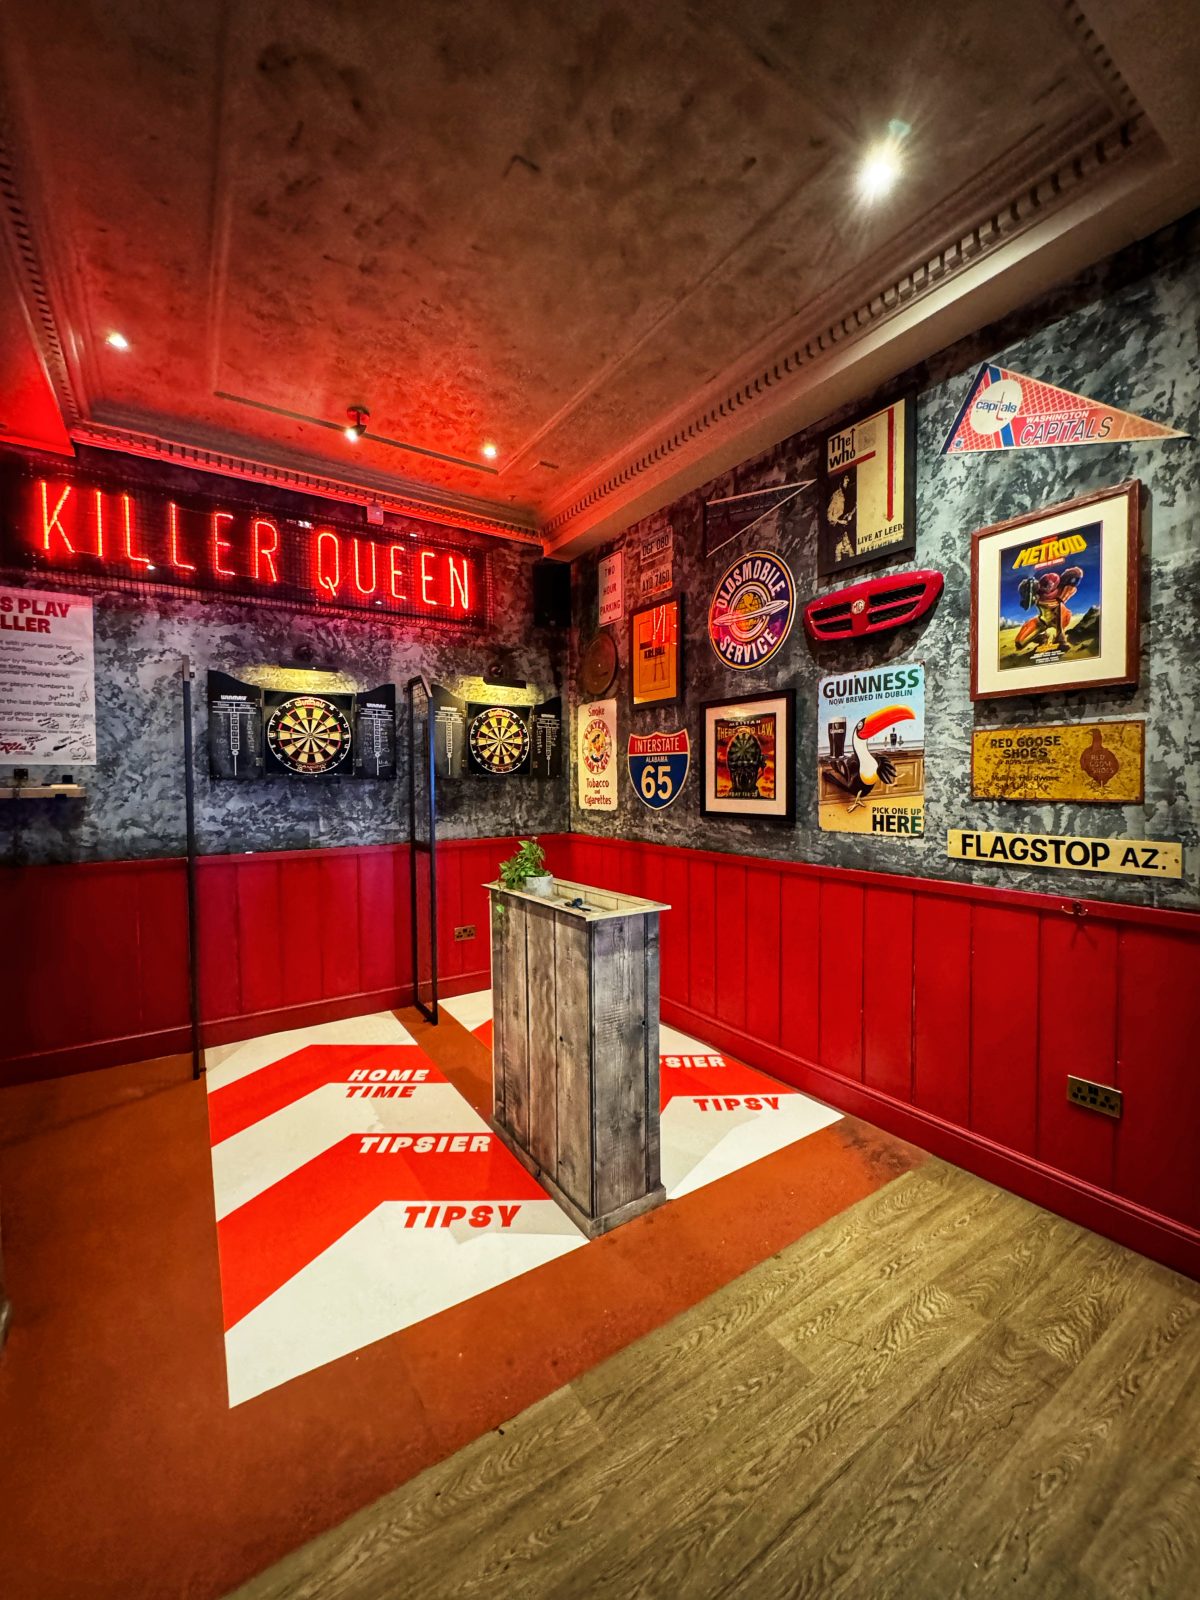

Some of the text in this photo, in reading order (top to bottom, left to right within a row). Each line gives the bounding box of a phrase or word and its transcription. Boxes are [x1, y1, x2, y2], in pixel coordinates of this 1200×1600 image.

[1026, 411, 1089, 423] WASHINGTON
[1020, 416, 1113, 445] CAPITALS
[830, 434, 851, 454] The
[857, 533, 873, 545] LIVE
[874, 529, 883, 540] AT
[40, 481, 468, 609] KILLER QUEEN
[1012, 534, 1087, 569] METROID
[604, 565, 616, 577] TWO
[603, 583, 617, 595] HOUR
[716, 559, 786, 609] OLDSMOBILE
[18, 598, 71, 618] PLAY
[600, 599, 621, 616] PARKING
[720, 628, 778, 663] SERVICE
[823, 669, 920, 699] GUINNESS
[846, 694, 874, 704] BREWED
[875, 692, 883, 700] IN
[885, 689, 912, 699] DUBLIN
[588, 706, 605, 717] Smoke
[757, 722, 773, 736] LAW
[634, 737, 680, 752] INTERSTATE
[990, 736, 1062, 748] RED GOOSE
[645, 755, 669, 763] ALABAMA
[1003, 748, 1048, 759] SHOES
[586, 778, 609, 788] Tobacco
[641, 765, 672, 800] 65
[584, 795, 612, 806] Cigarettes
[891, 807, 908, 815] ONE
[872, 814, 922, 834] HERE
[961, 833, 1167, 870] FLAGSTOP AZ.
[659, 1056, 726, 1068] SIER
[347, 1069, 430, 1082] HOME
[345, 1085, 417, 1098] TIME
[693, 1097, 779, 1111] TIPSY
[359, 1135, 491, 1154] TIPSIER
[404, 1205, 522, 1229] TIPSY
